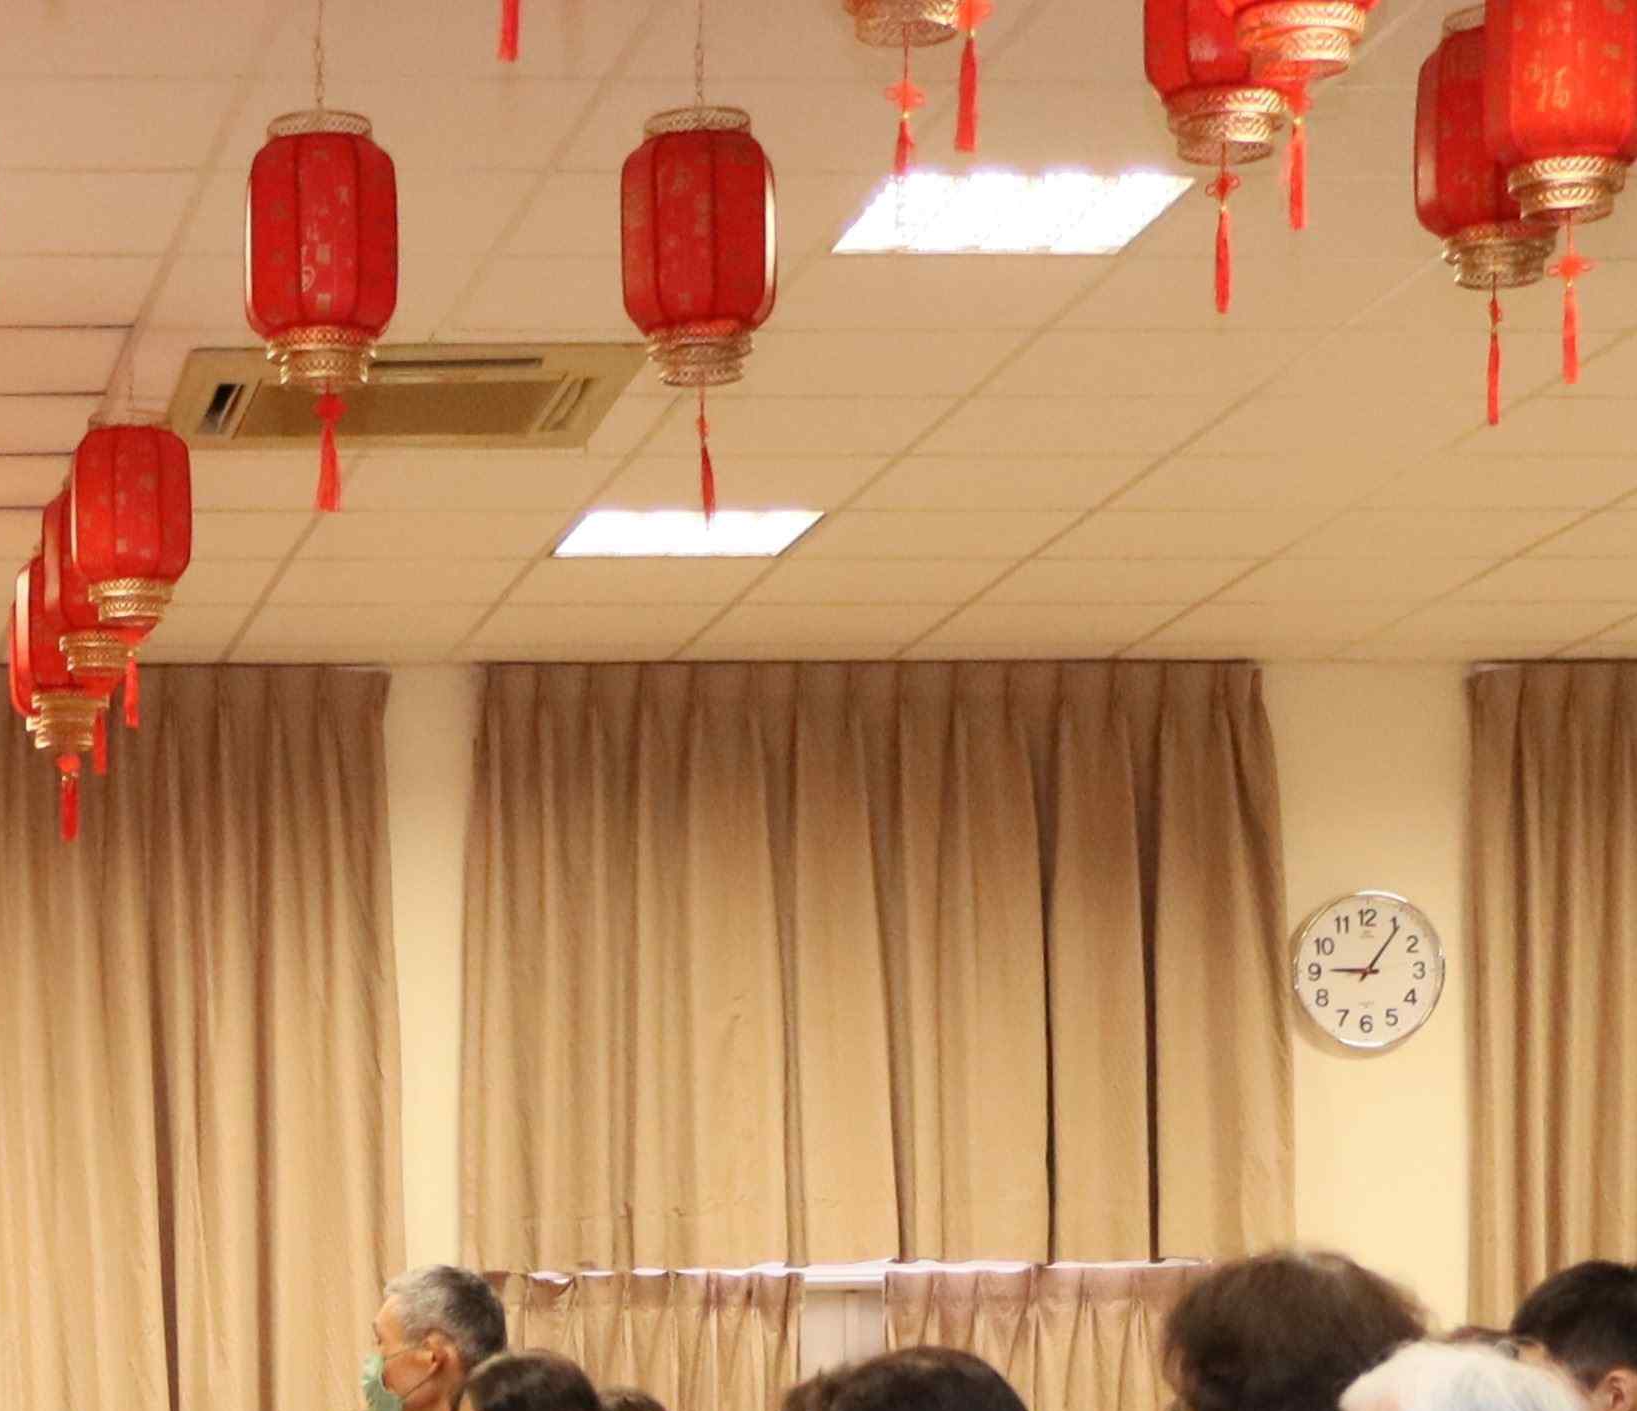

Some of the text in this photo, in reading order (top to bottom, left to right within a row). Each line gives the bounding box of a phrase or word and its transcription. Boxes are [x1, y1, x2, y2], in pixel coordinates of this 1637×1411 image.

[1334, 915, 1350, 934] 11
[1357, 908, 1378, 927] 12
[1390, 916, 1400, 934] 1
[1314, 937, 1335, 956] 10
[1406, 935, 1419, 953] 2
[1308, 963, 1322, 982] 9
[1412, 961, 1426, 980] 3
[1315, 989, 1329, 1007] 8
[1403, 988, 1417, 1006] 4
[1336, 1008, 1350, 1027] 7
[1359, 1015, 1373, 1034] 6
[1385, 1008, 1399, 1026] 5
